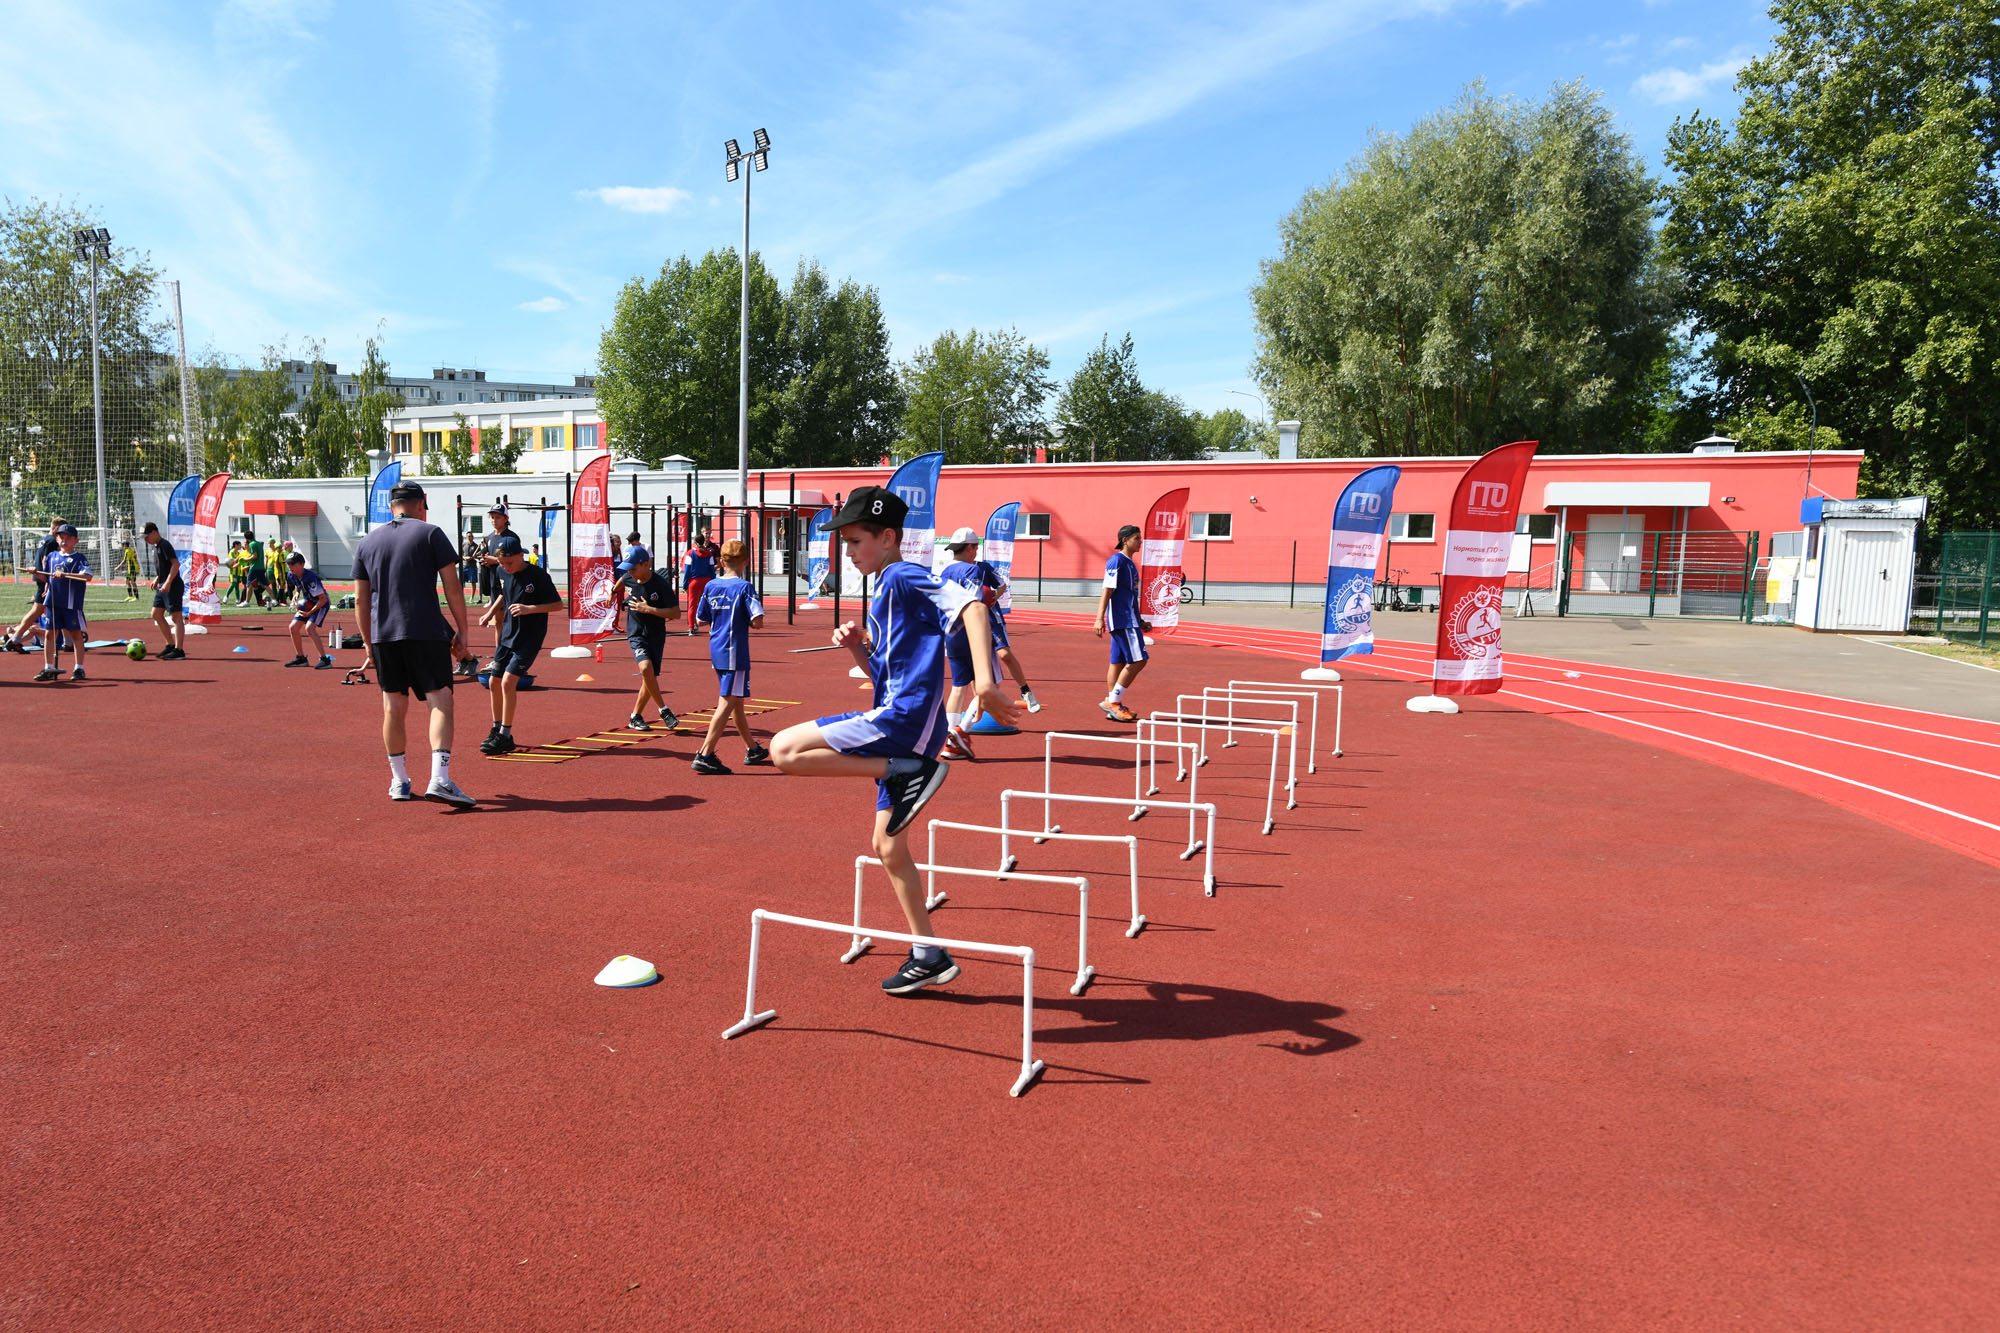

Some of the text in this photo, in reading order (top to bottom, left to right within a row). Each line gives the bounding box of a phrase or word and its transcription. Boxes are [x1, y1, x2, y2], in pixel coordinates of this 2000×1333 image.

[581, 487, 601, 505] ГТО
[1468, 481, 1509, 508] ГТО
[872, 500, 883, 515] 8
[1349, 492, 1382, 514] ГТО
[992, 518, 1010, 530] ГТО
[1155, 511, 1178, 526] ГТО
[1480, 631, 1498, 644] ГТО
